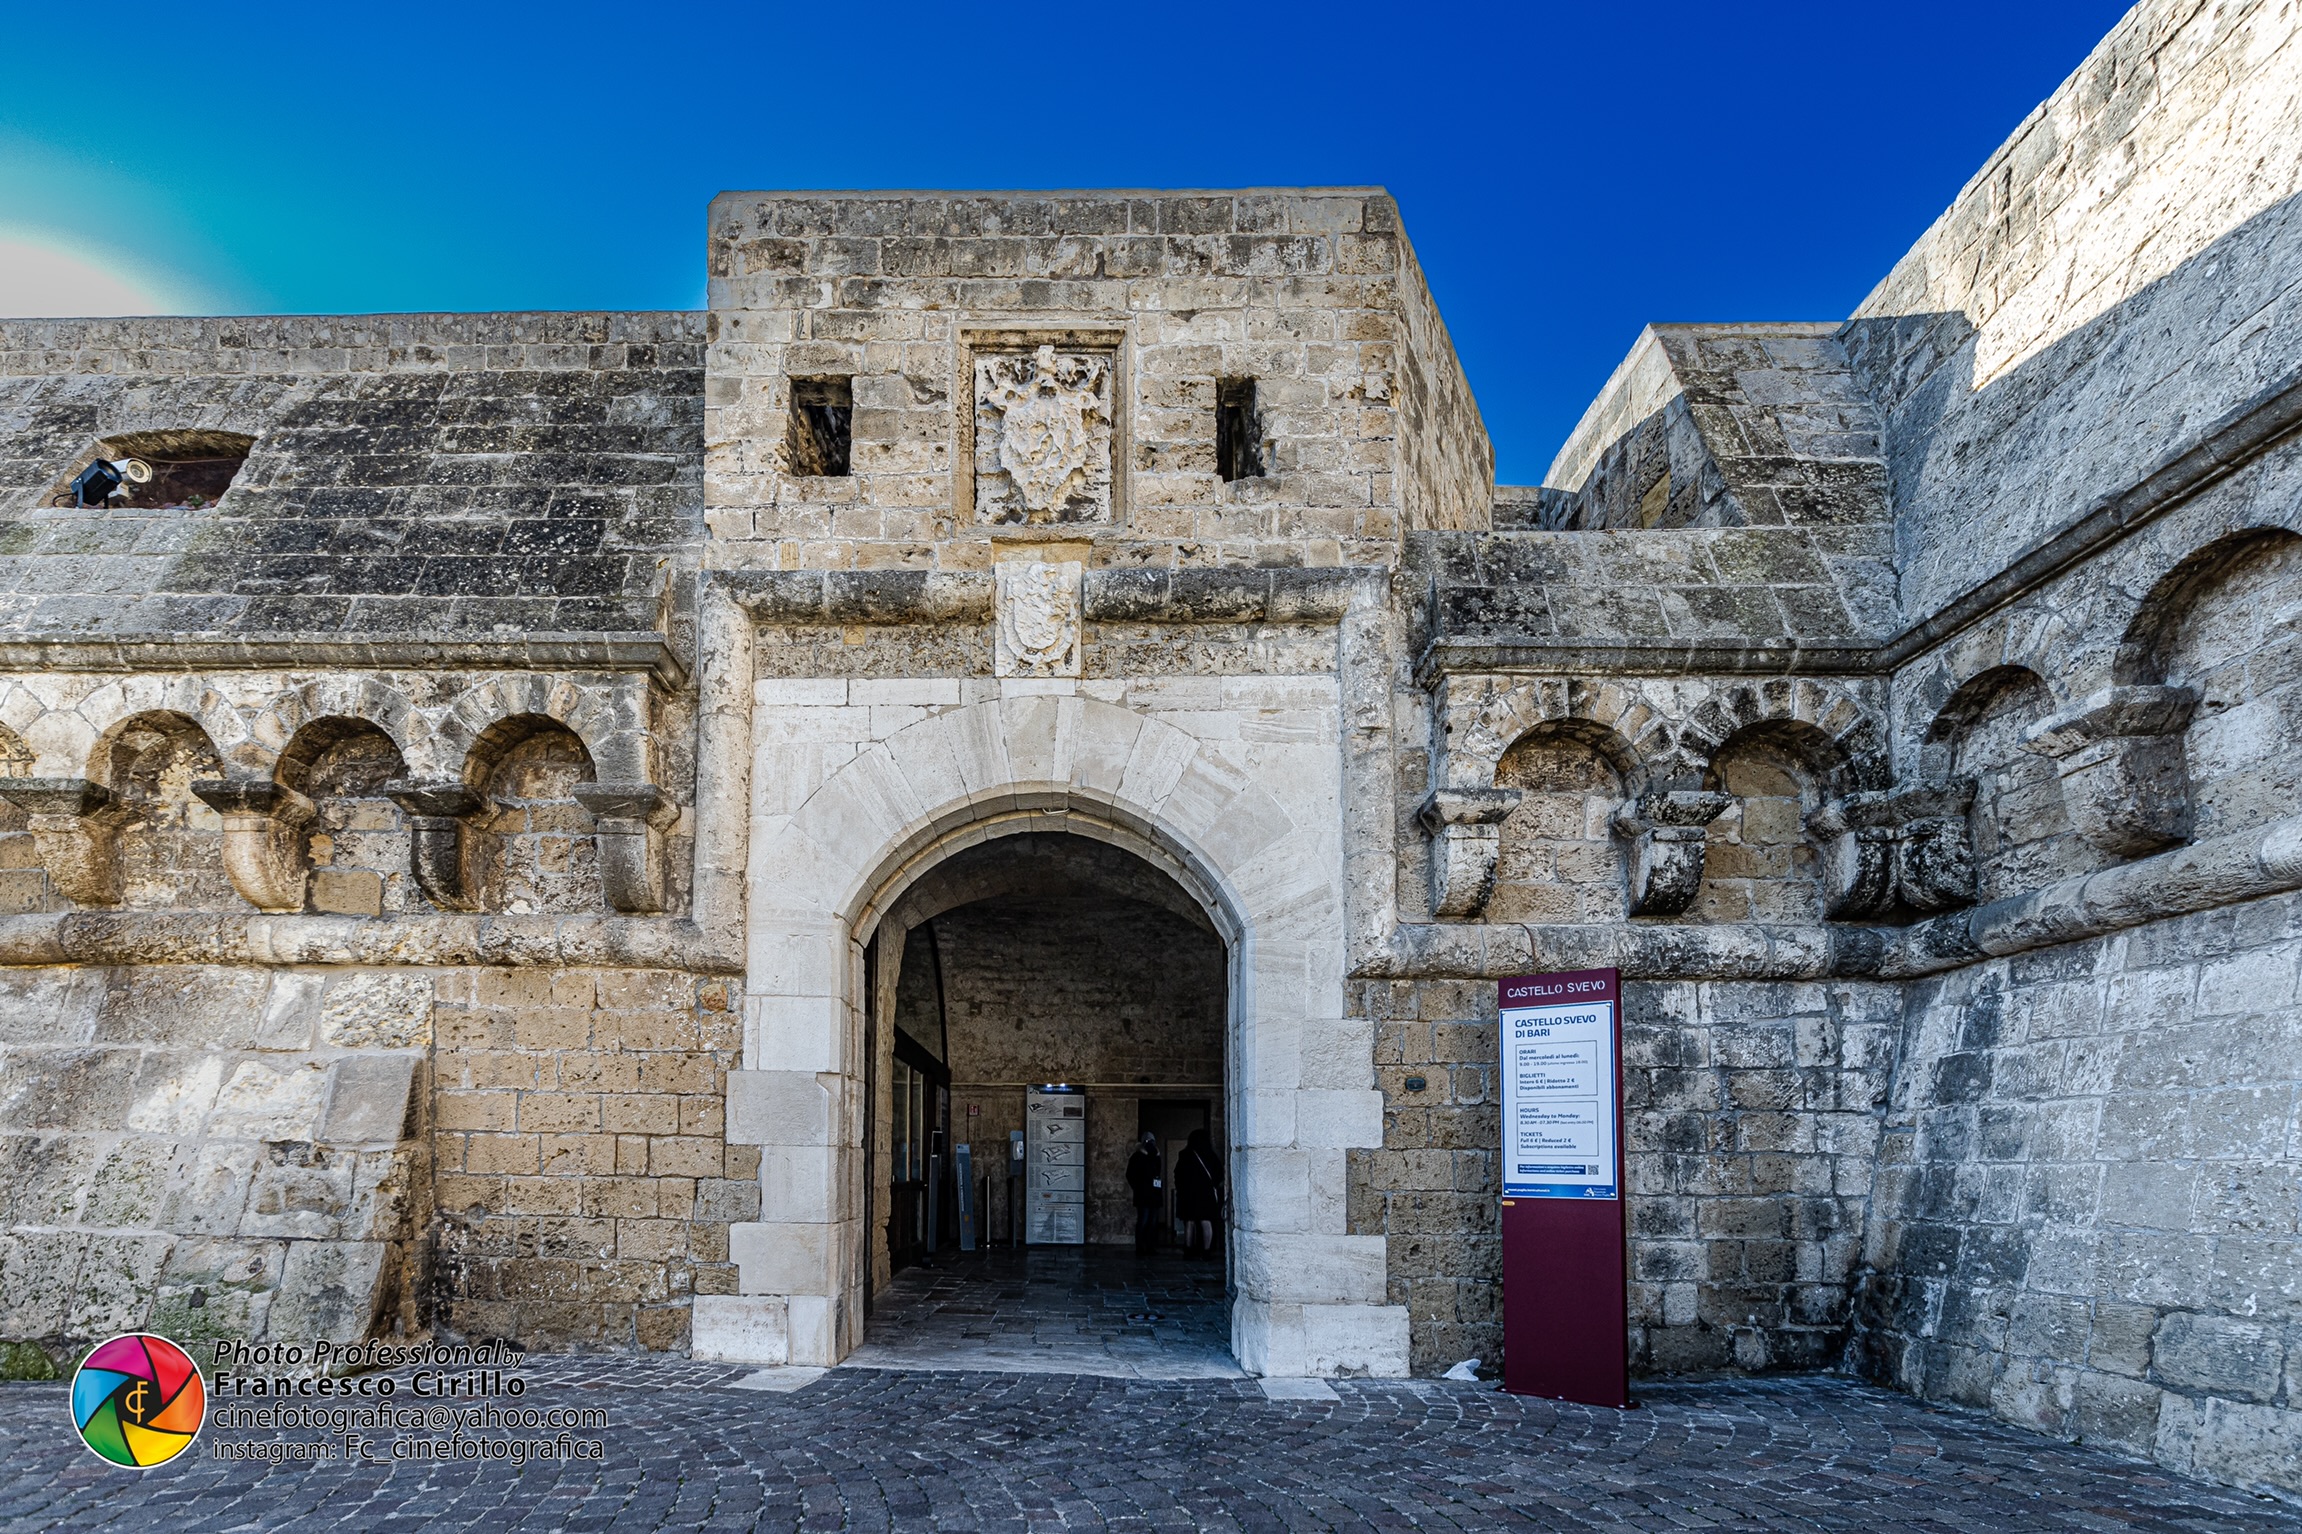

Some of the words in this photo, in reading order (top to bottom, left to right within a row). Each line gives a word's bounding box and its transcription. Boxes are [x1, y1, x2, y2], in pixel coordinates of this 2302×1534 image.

[1507, 984, 1563, 998] CASTELLO
[1567, 980, 1605, 993] SVEVO
[1515, 1016, 1562, 1028] CASTELLO
[1564, 1014, 1597, 1025] SVEVO
[1515, 1030, 1525, 1038] DI
[1527, 1028, 1550, 1038] BARI
